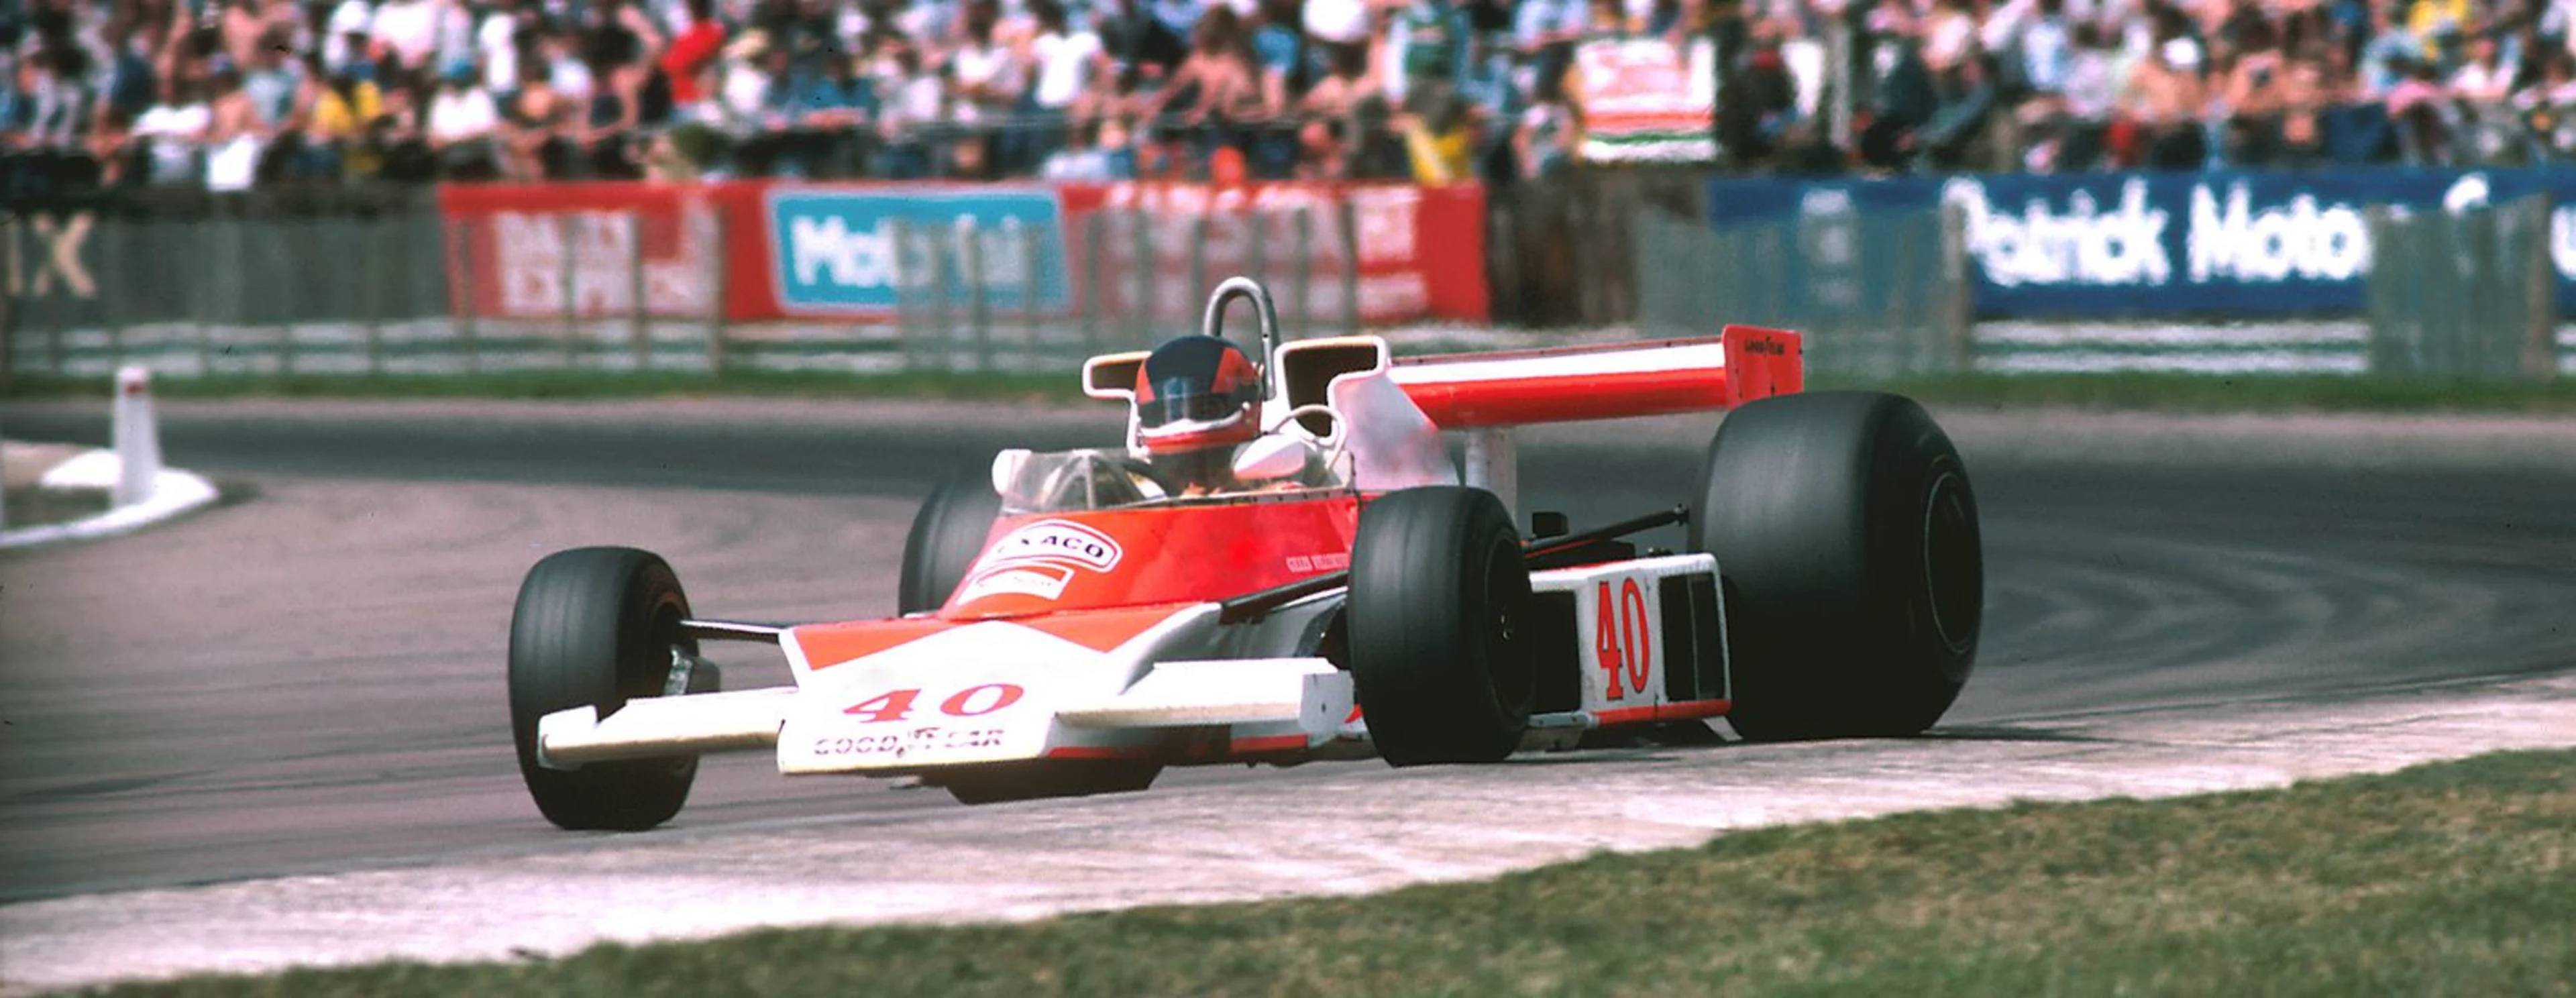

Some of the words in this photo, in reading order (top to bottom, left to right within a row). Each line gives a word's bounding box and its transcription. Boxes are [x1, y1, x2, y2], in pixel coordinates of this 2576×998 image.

[792, 212, 1040, 288] Motfai
[1941, 176, 2170, 286] Patrick
[983, 535, 1106, 561] ACO
[1597, 577, 1650, 700] 40
[843, 683, 1024, 724] 40
